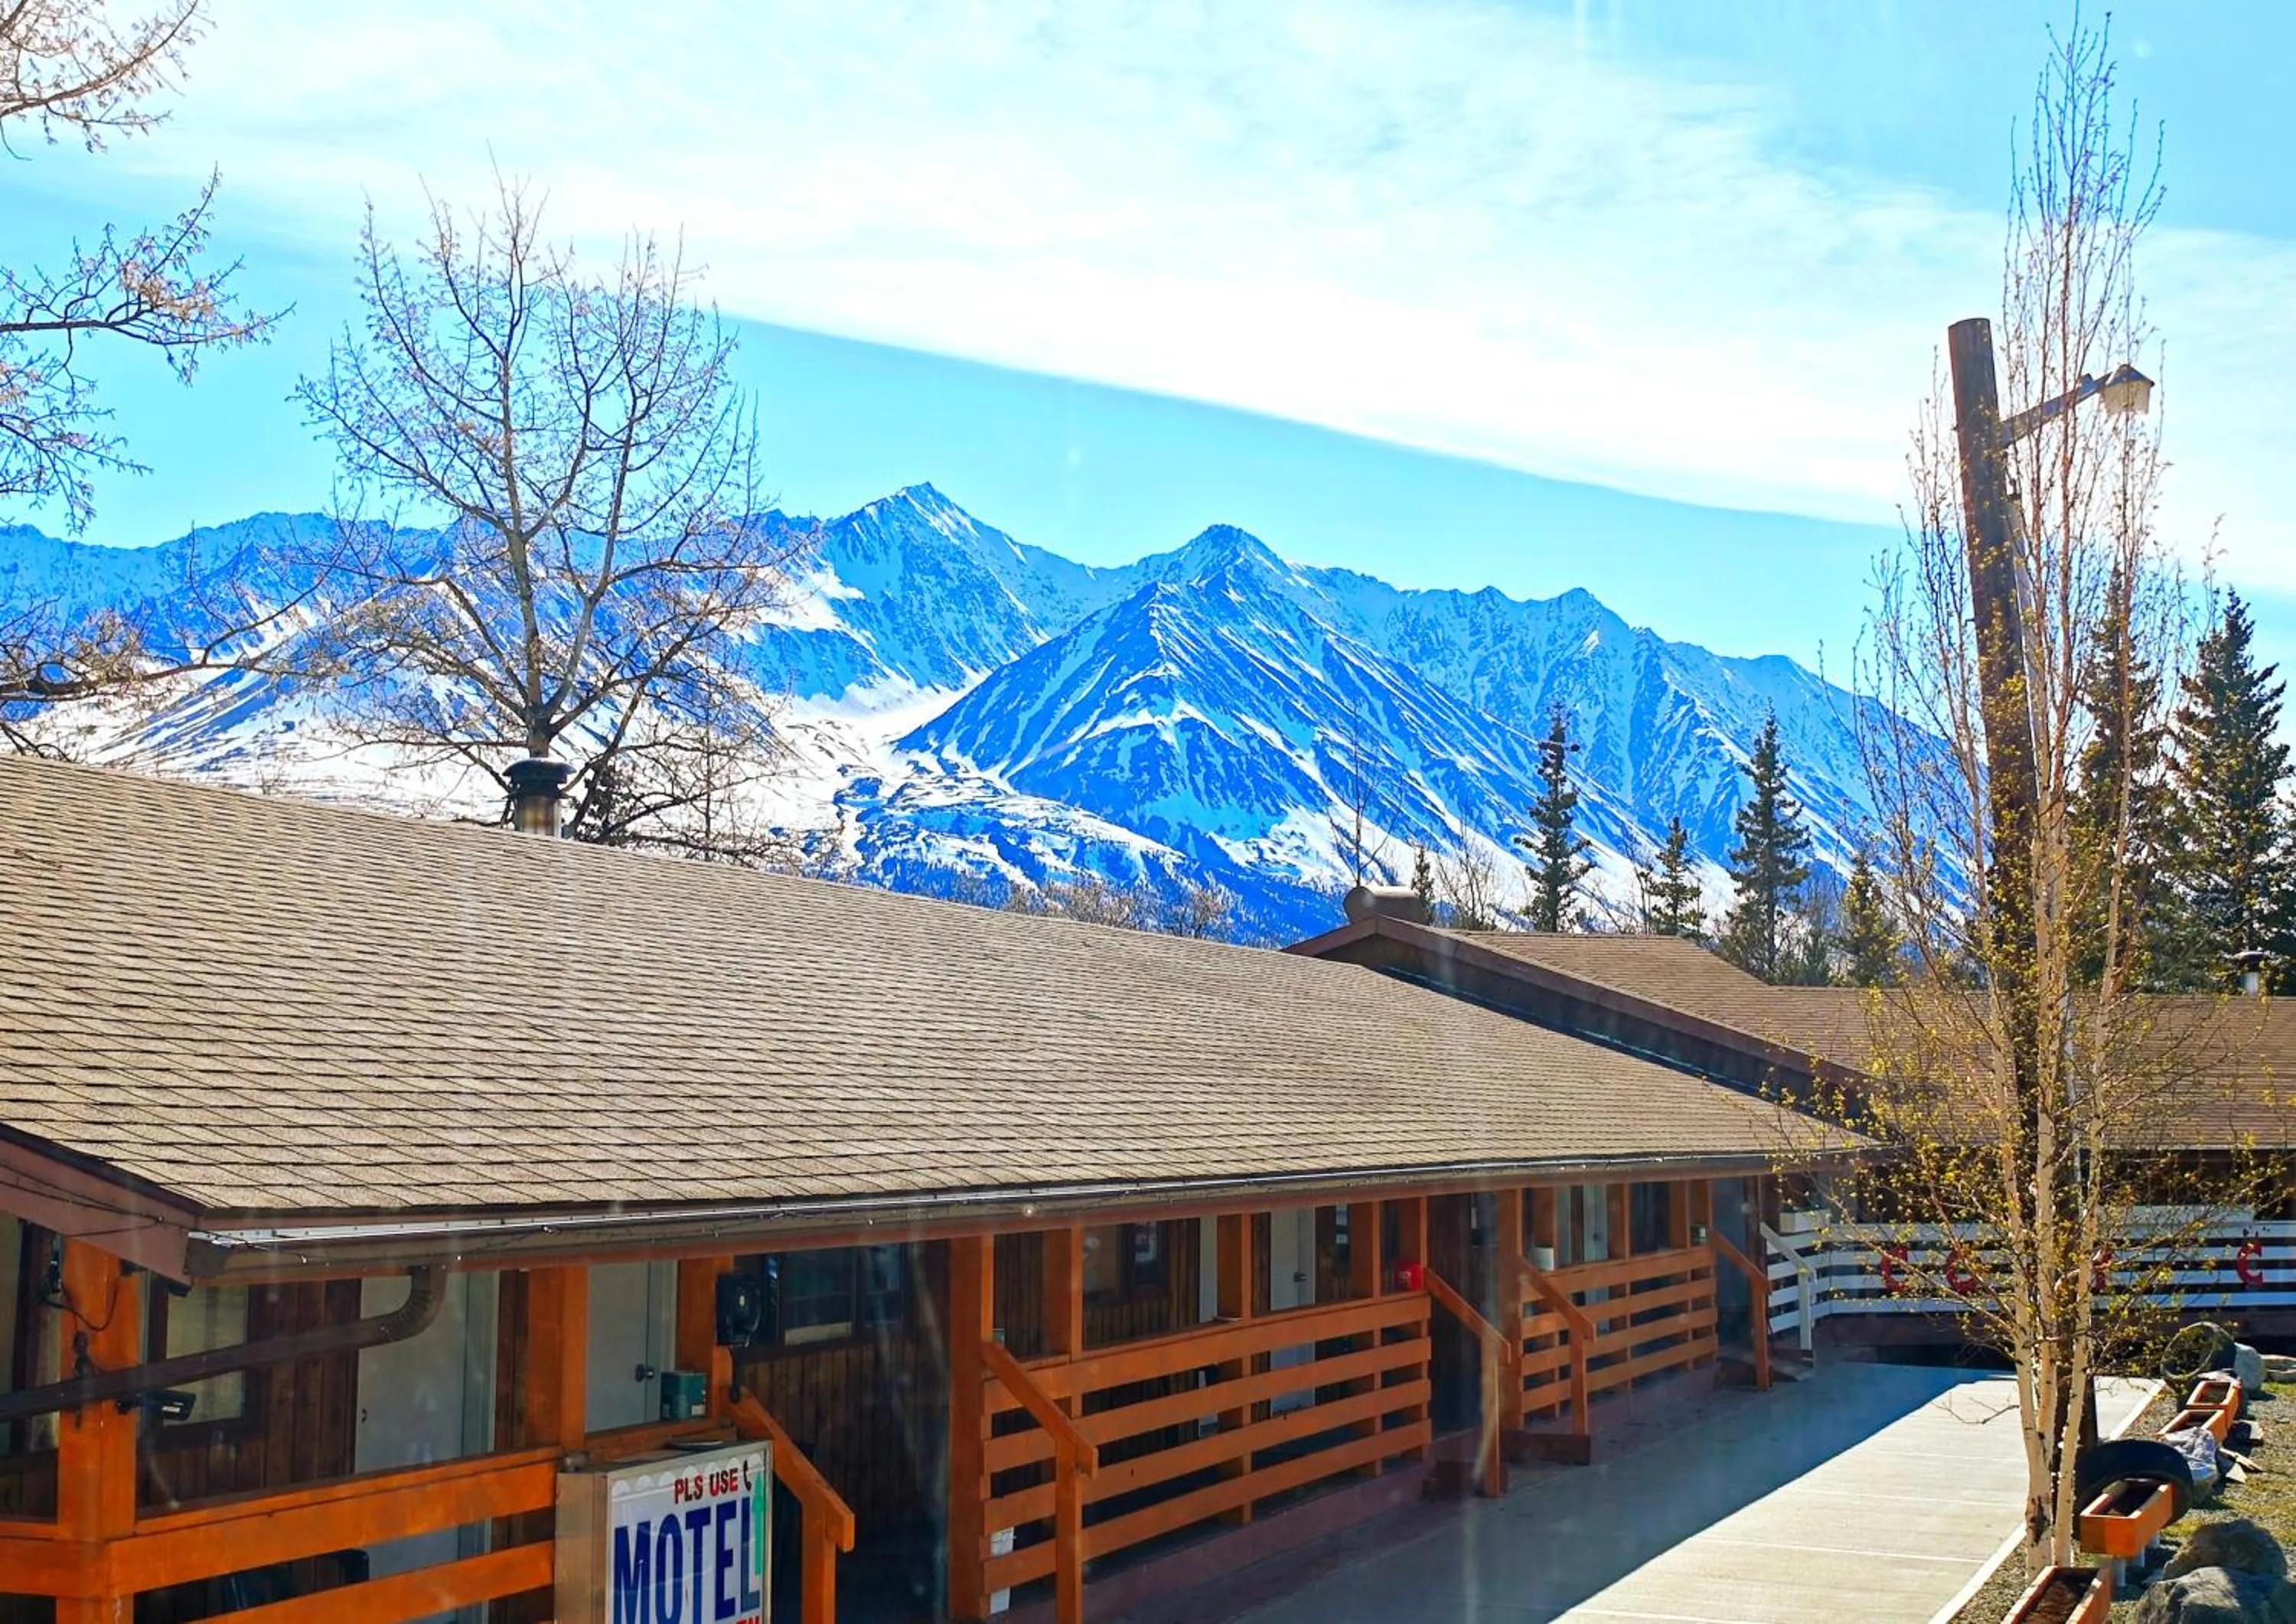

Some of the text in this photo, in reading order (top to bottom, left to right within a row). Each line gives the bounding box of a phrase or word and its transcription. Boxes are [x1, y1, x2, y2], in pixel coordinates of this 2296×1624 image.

[674, 1468, 739, 1504] PLS USE
[614, 1497, 760, 1624] MOTEL
